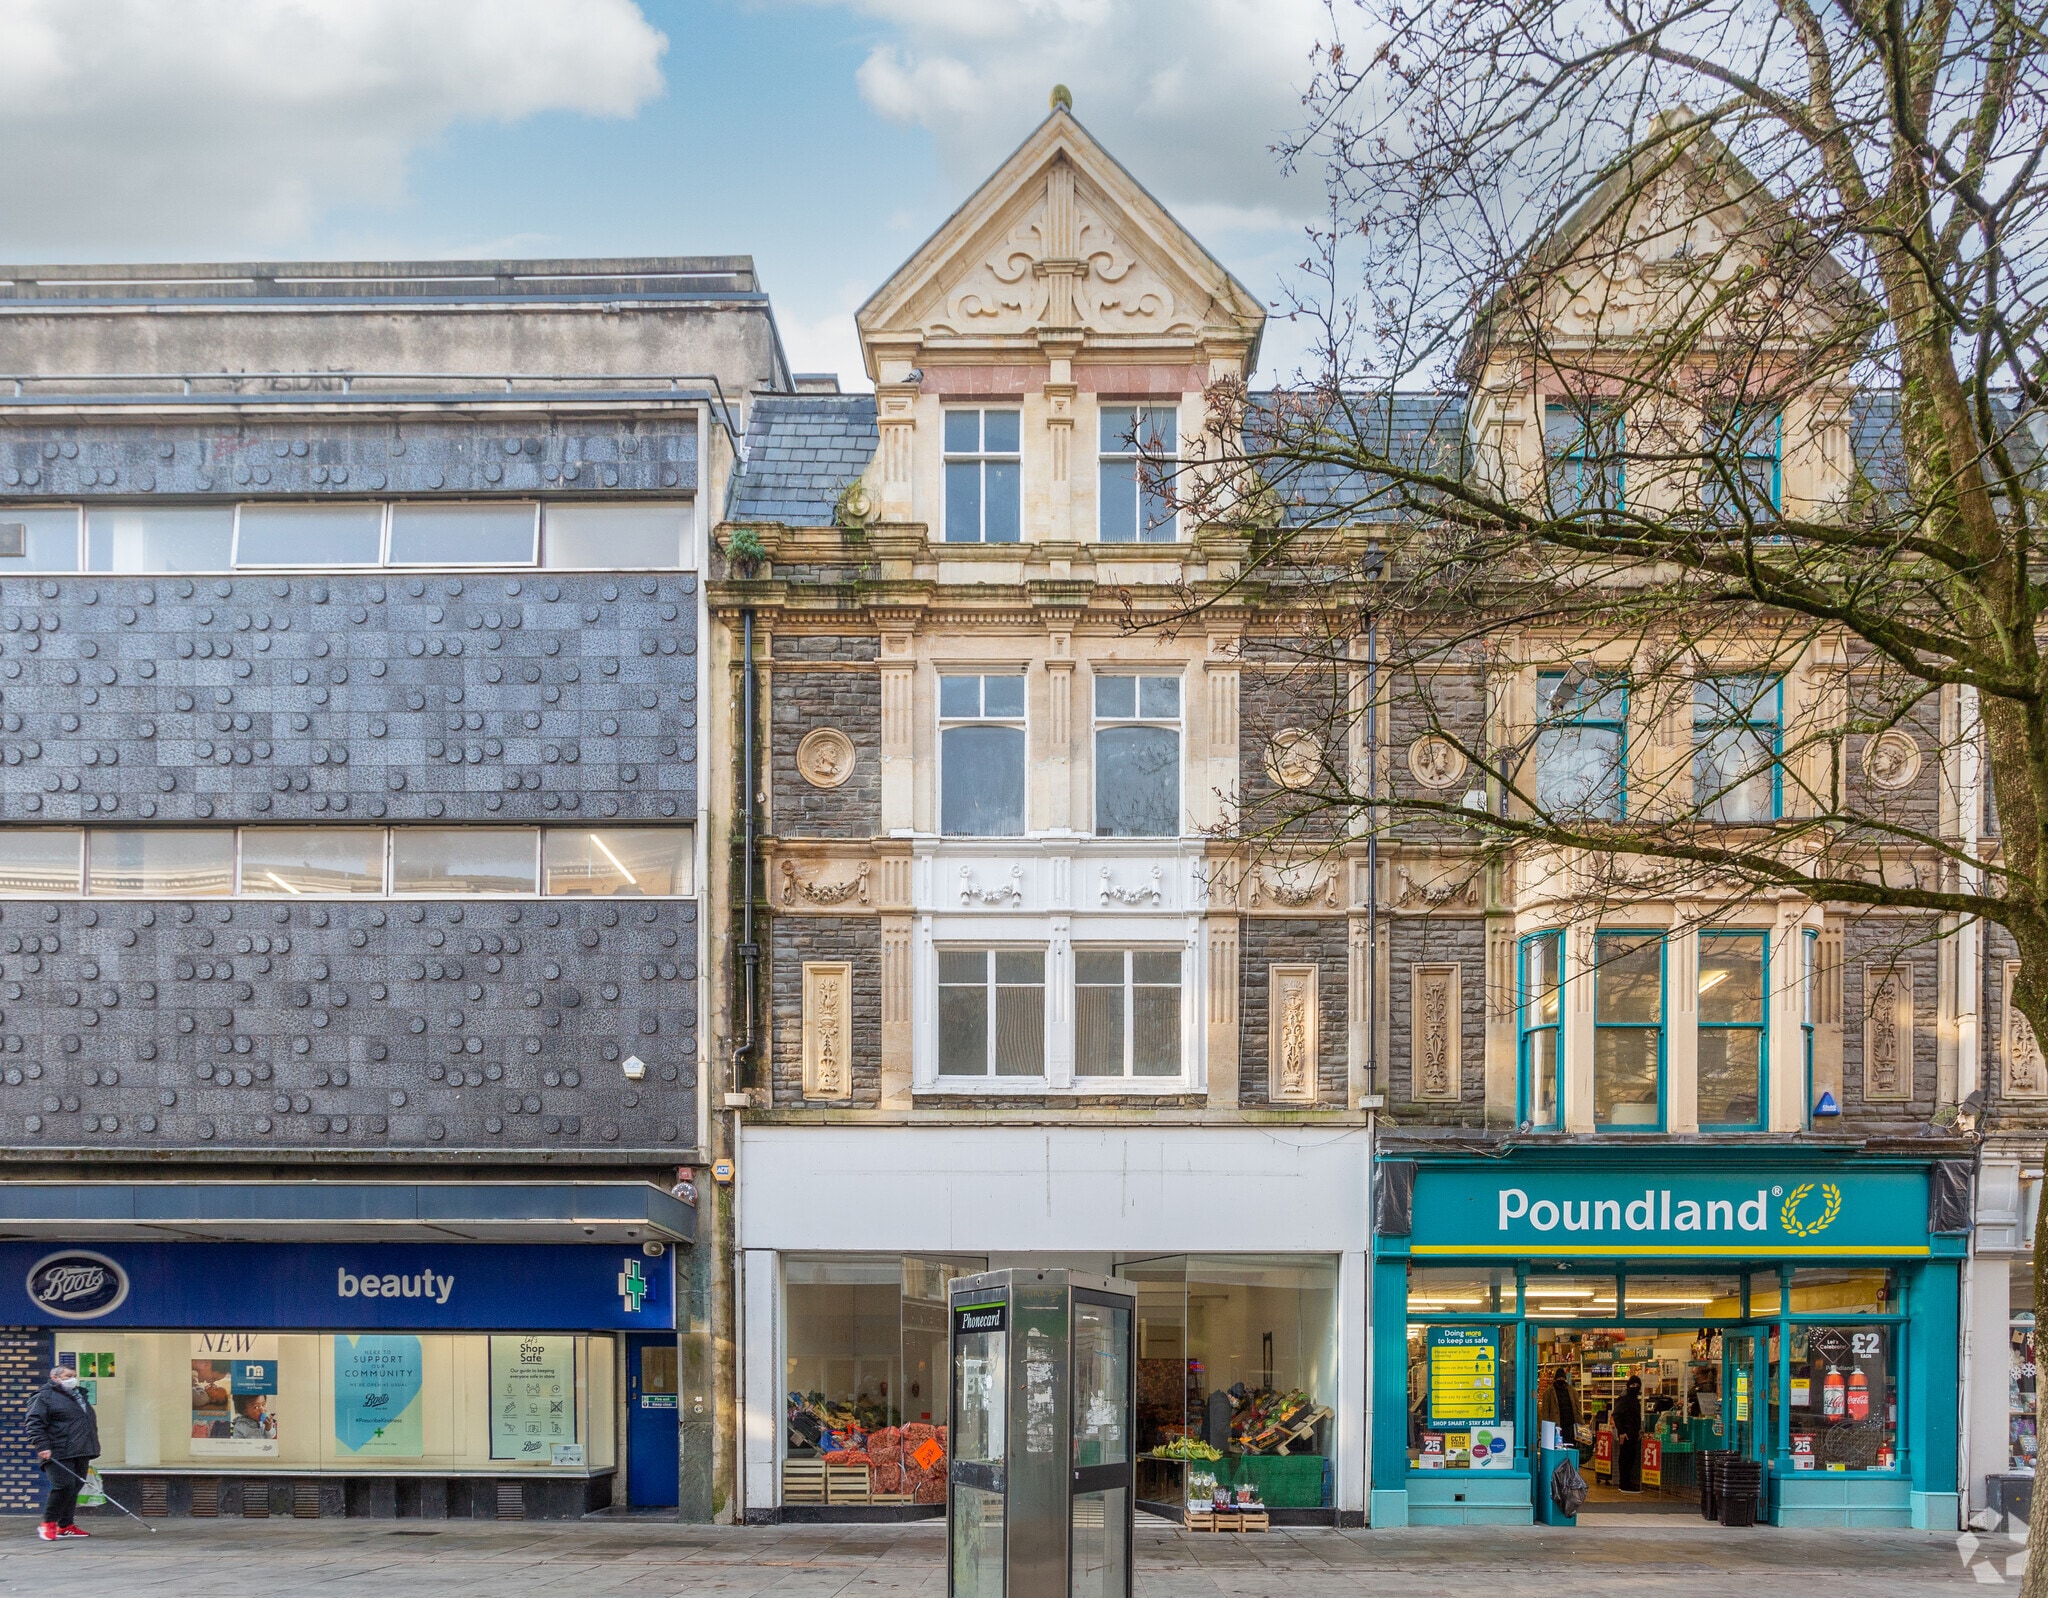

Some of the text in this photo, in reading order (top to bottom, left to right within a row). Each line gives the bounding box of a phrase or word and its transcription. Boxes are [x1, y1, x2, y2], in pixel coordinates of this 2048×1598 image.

[1499, 1188, 1767, 1231] Poundland
[39, 1265, 104, 1301] Boots
[337, 1267, 454, 1304] beauty
[961, 1309, 1000, 1329] Phonecard
[197, 1333, 258, 1353] NEW
[1446, 1337, 1463, 1345] keep
[1851, 1333, 1880, 1354] £2
[520, 1343, 545, 1355] Shop
[1636, 1347, 1648, 1357] Food
[353, 1355, 403, 1363] SUPPORT
[520, 1353, 542, 1362] Safe
[344, 1370, 413, 1378] COMMUNITY
[362, 1393, 389, 1408] Boots
[1425, 1440, 1440, 1452] 25
[1597, 1439, 1609, 1457] £1
[1794, 1441, 1811, 1453] 25
[1643, 1447, 1657, 1466] £1
